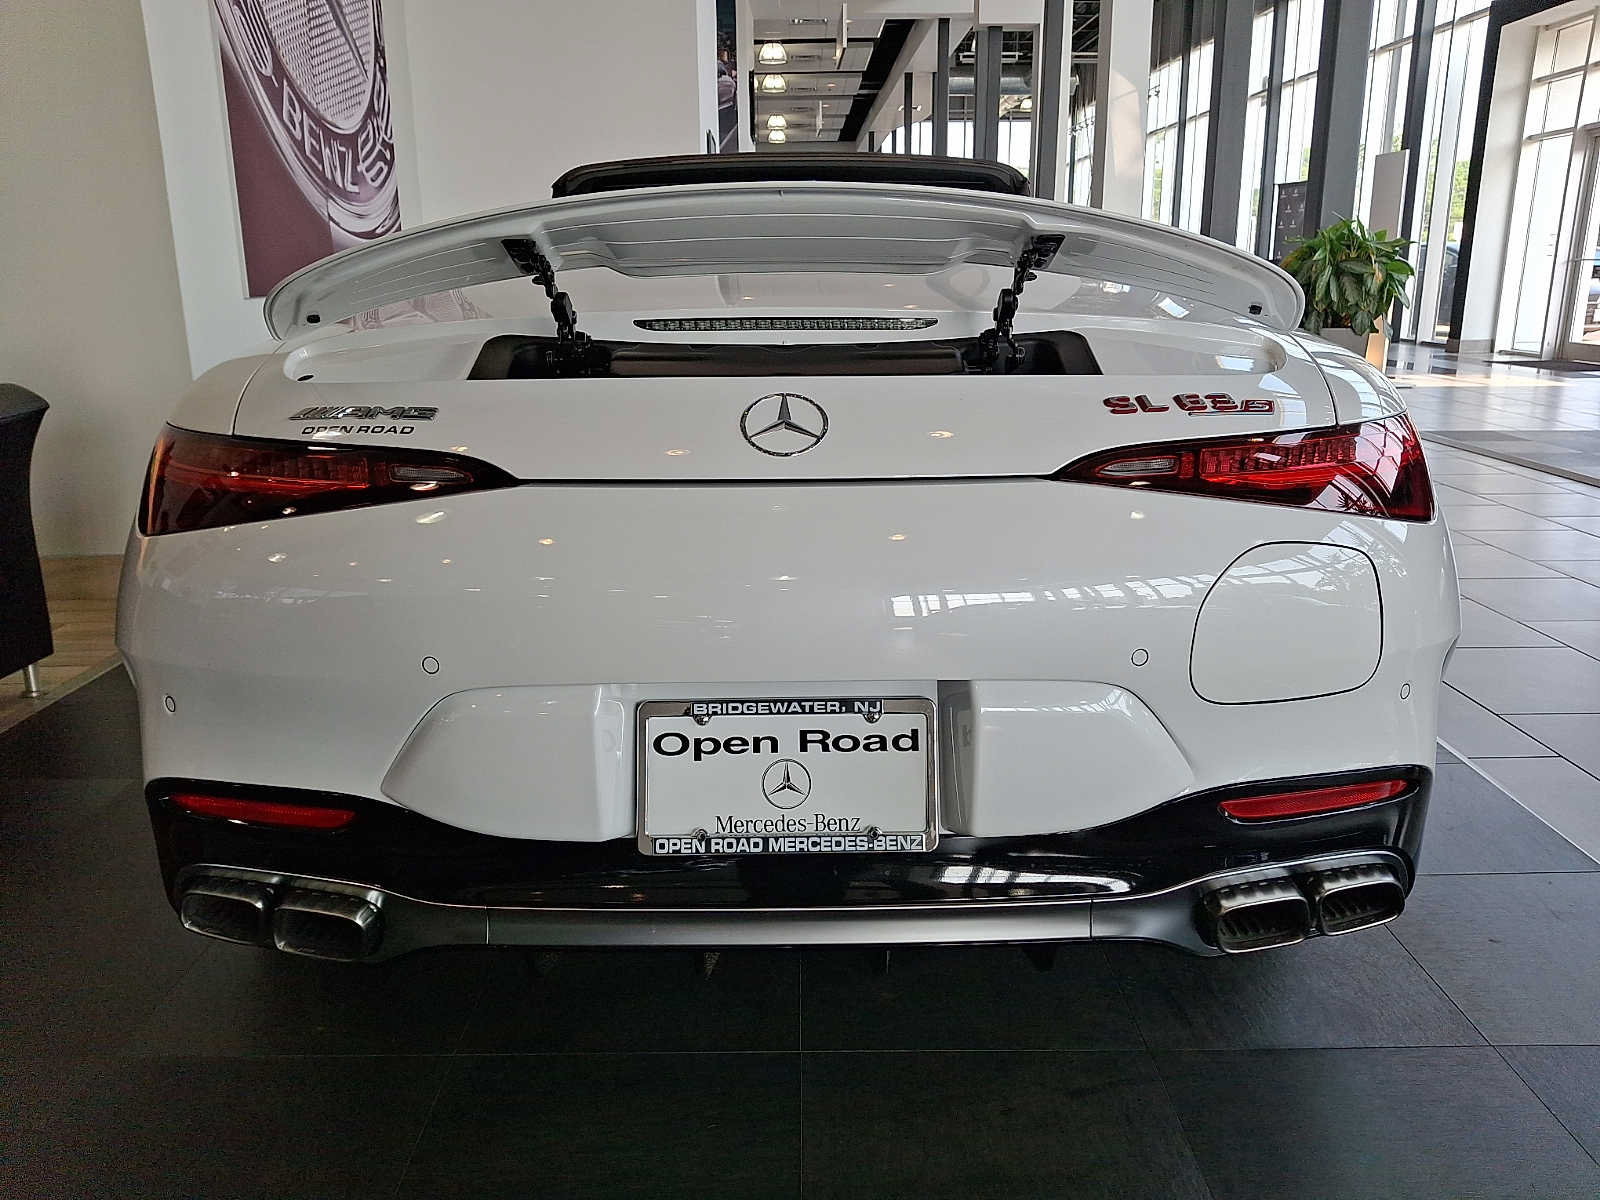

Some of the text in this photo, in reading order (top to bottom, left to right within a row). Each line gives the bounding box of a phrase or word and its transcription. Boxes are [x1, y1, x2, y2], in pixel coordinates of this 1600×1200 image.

[283, 78, 360, 193] BENZ
[332, 406, 440, 421] AMG
[1102, 394, 1170, 415] SL
[356, 425, 415, 436] ROAD
[693, 701, 881, 715] BRIDGEWATER, NJ
[652, 728, 920, 762] Open Road
[715, 813, 861, 835] Mercedes-Benz
[654, 835, 924, 854] OPEN ROAD MERCEDES-BENZ
